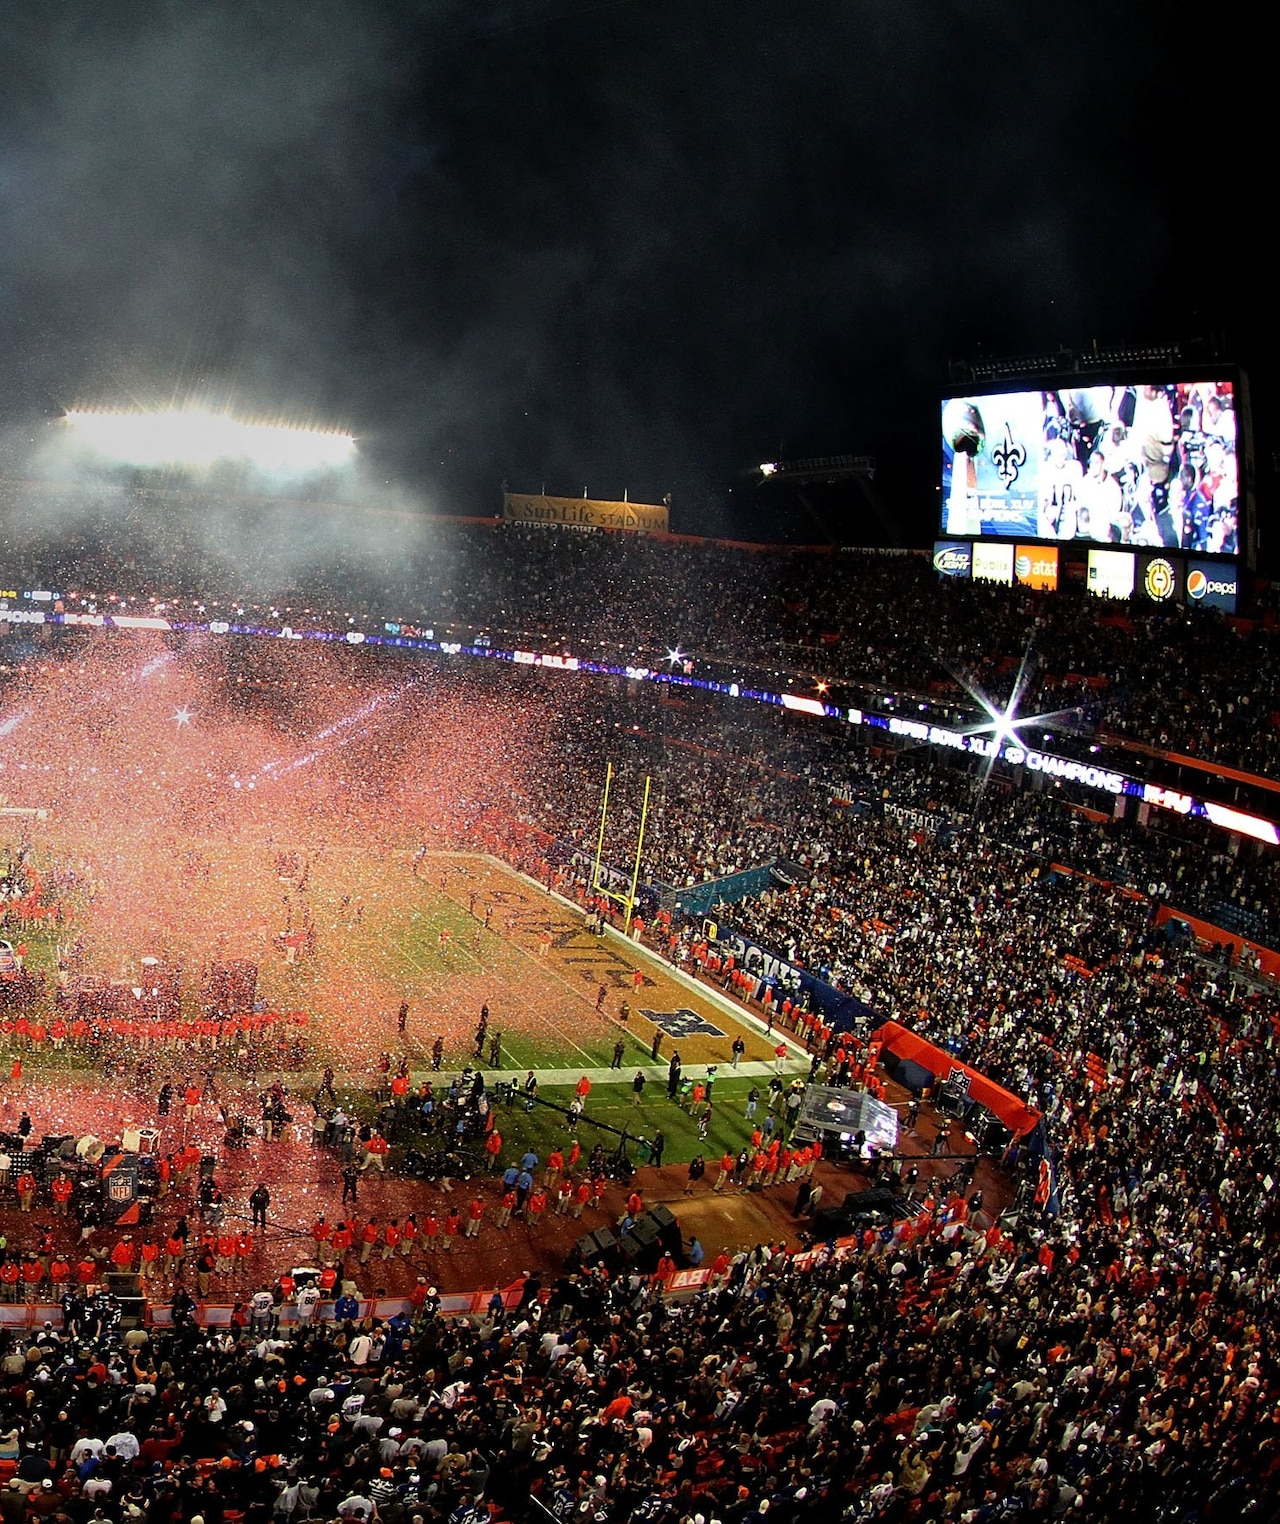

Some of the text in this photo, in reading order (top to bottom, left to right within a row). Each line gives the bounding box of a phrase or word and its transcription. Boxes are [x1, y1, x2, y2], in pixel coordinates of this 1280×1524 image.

[524, 503, 666, 529] Sun Life STADIUM
[944, 552, 969, 562] BUD
[938, 560, 971, 570] LIGHT
[1032, 560, 1058, 577] at&t
[1207, 582, 1236, 595] pepsi
[929, 728, 967, 750] BOWL
[1026, 752, 1124, 794] CHAMPIONS
[112, 1186, 129, 1198] NFL
[84, 1311, 91, 1321] 5
